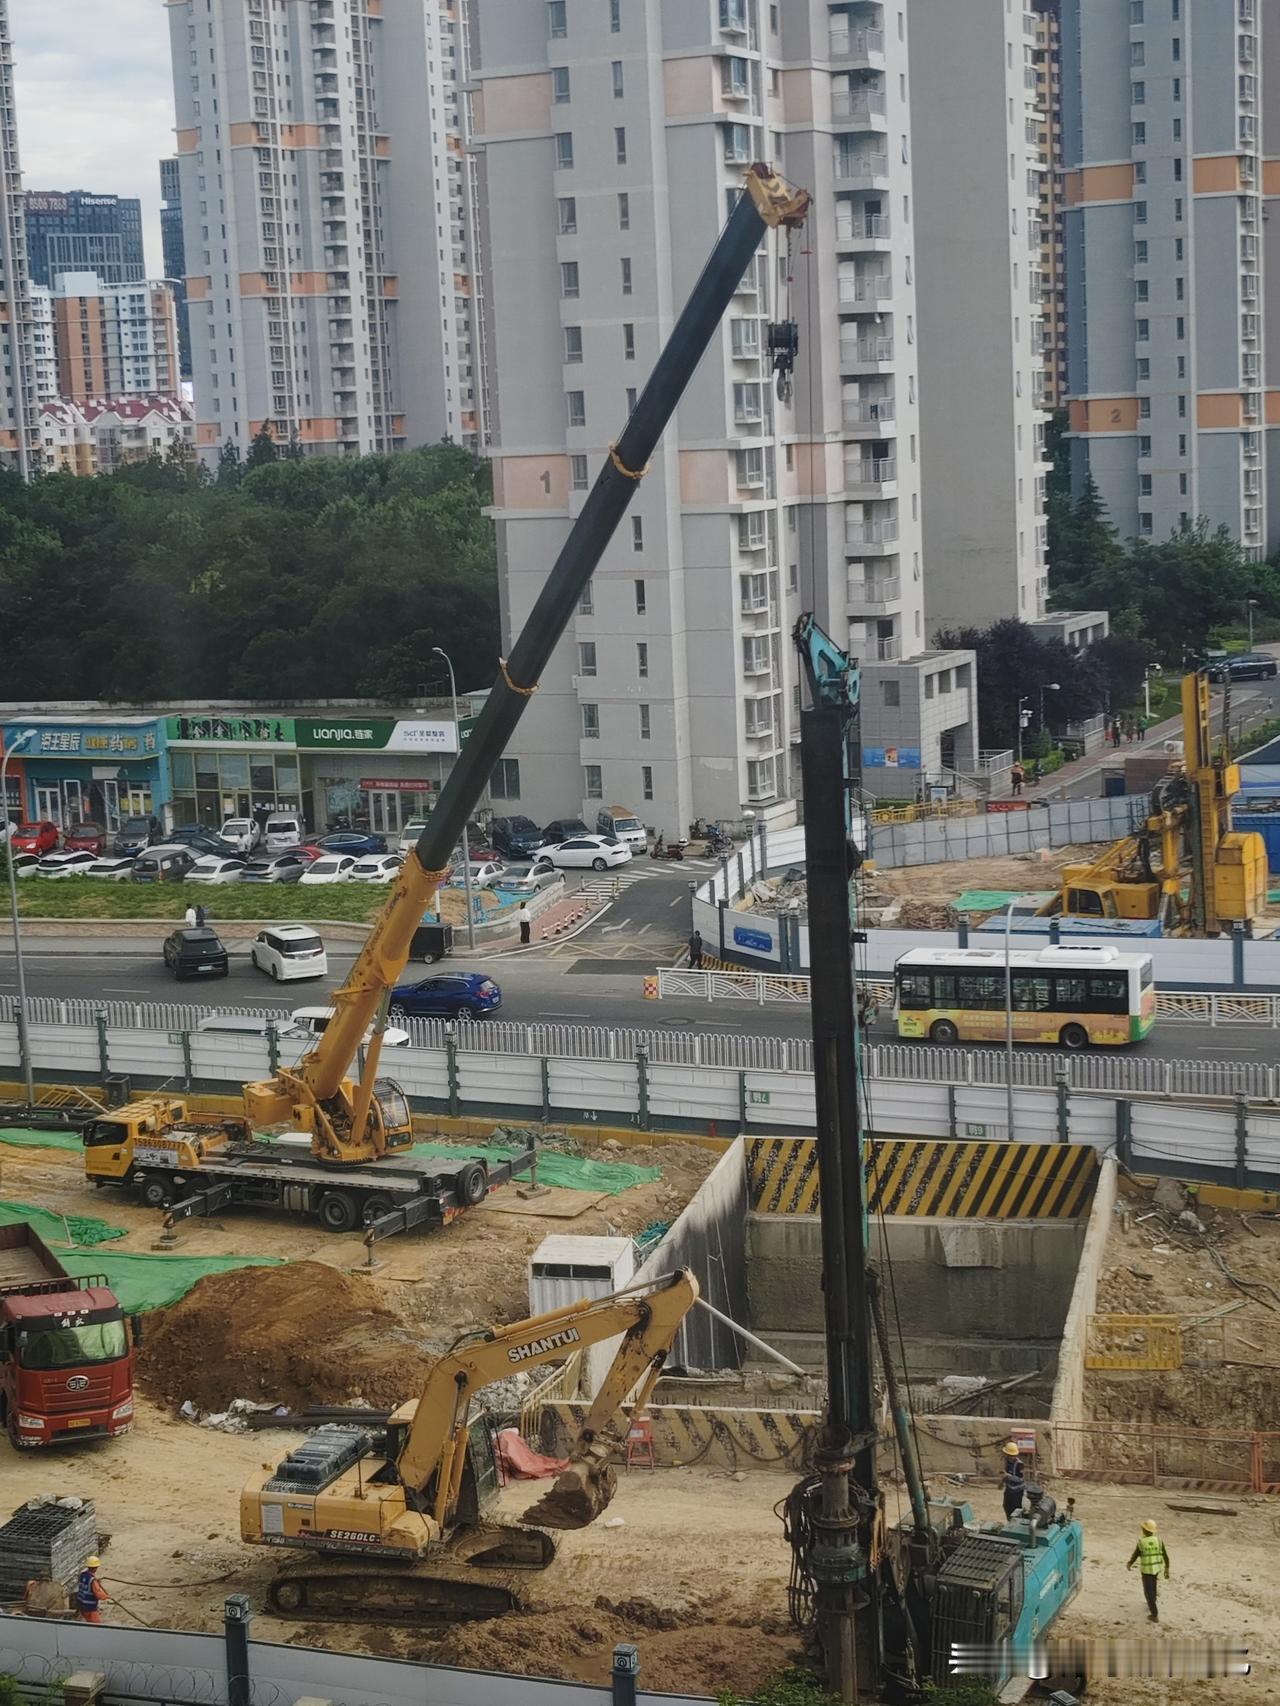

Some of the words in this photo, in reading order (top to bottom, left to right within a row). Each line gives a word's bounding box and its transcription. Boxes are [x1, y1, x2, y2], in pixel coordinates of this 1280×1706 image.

[80, 196, 117, 206] Hisense
[1111, 408, 1121, 423] 2
[539, 470, 551, 494] 1
[507, 1327, 581, 1363] SHANTUI
